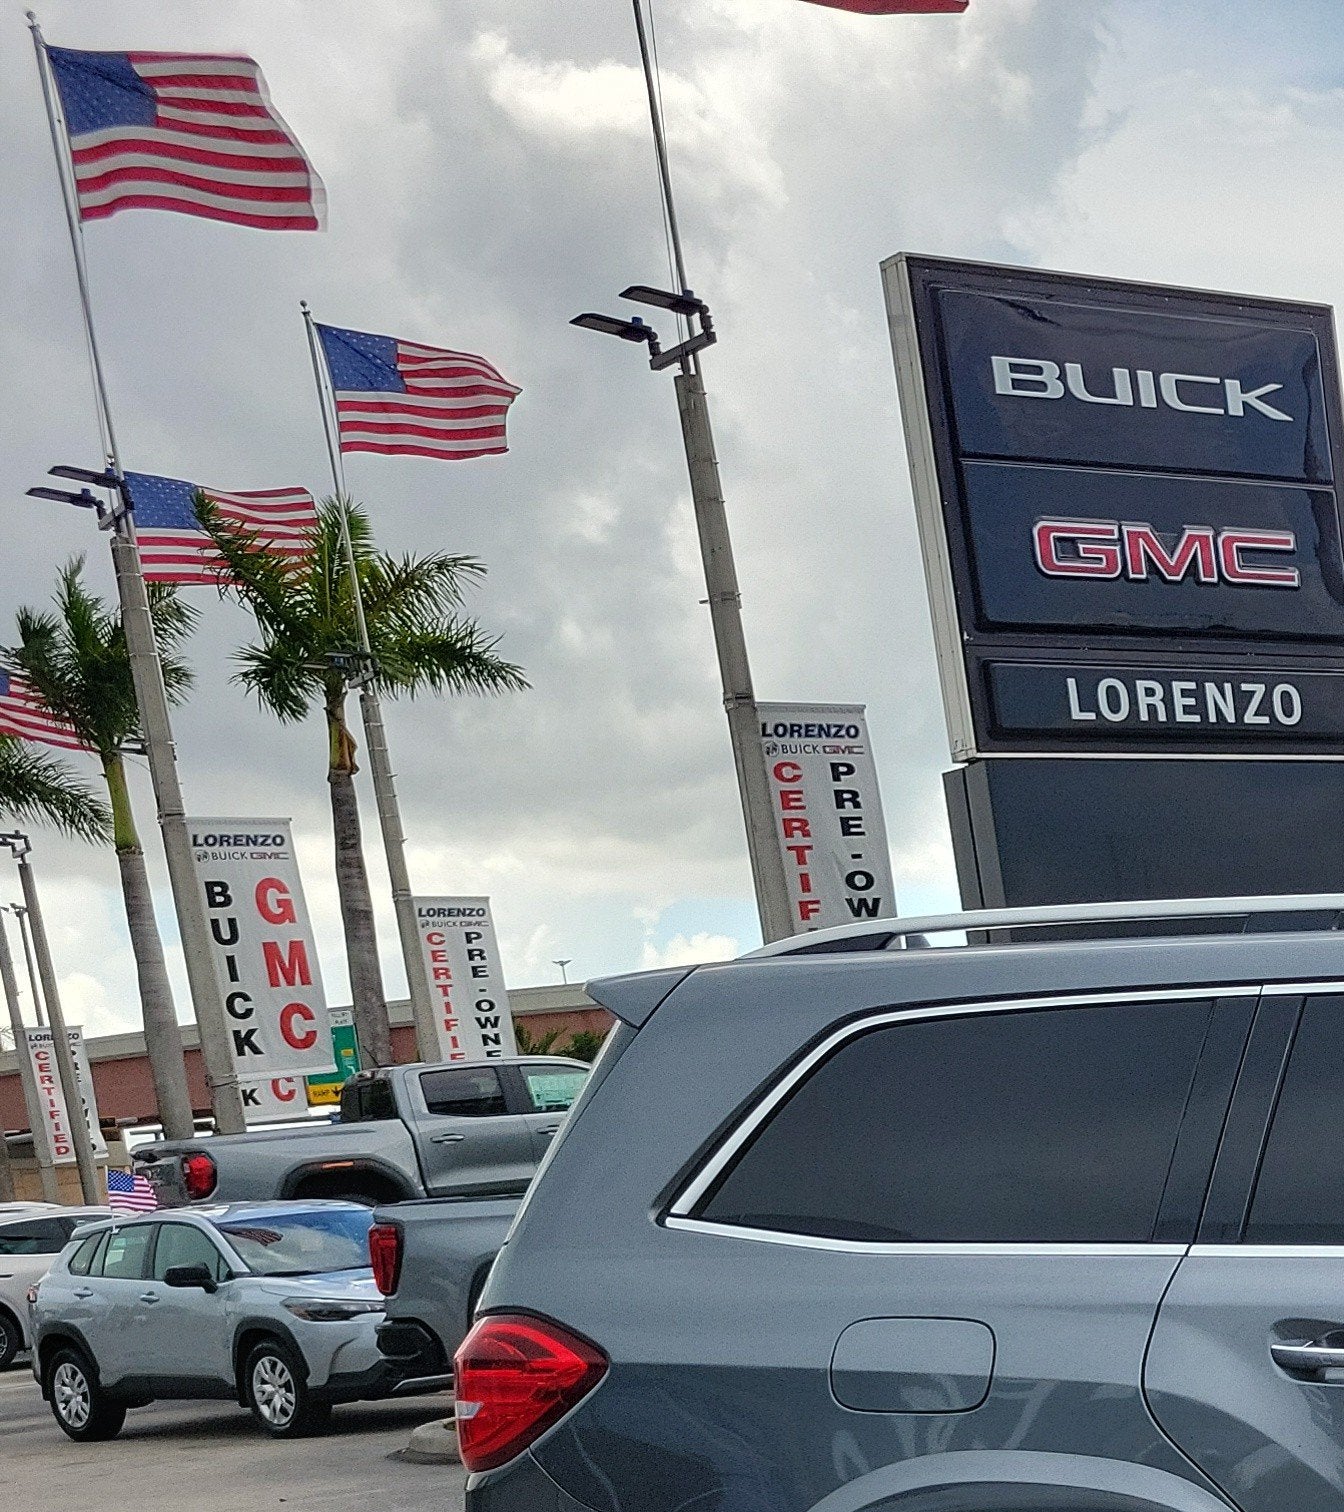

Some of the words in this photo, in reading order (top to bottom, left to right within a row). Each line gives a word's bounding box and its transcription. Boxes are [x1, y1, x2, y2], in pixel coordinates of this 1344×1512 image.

[990, 355, 1293, 422] BUICK
[1033, 516, 1299, 587] GMC
[761, 723, 859, 739] LORENZO
[1066, 678, 1302, 726] LORENZO
[781, 744, 820, 755] BUICK
[822, 745, 865, 755] GMC
[192, 834, 285, 847] LORENZO
[211, 851, 248, 861] BUICK
[250, 852, 290, 860] GMC
[773, 761, 821, 921] CERTIF
[829, 762, 881, 918] PRE-OW
[418, 907, 486, 918] LORENZO
[432, 920, 458, 928] BUICK
[204, 880, 265, 1057] BUICK
[255, 877, 318, 1050] GMC
[426, 932, 465, 1061] CERTIFIE
[465, 931, 502, 1058] PRE-OWNE
[35, 1051, 70, 1156] CERTIFIED
